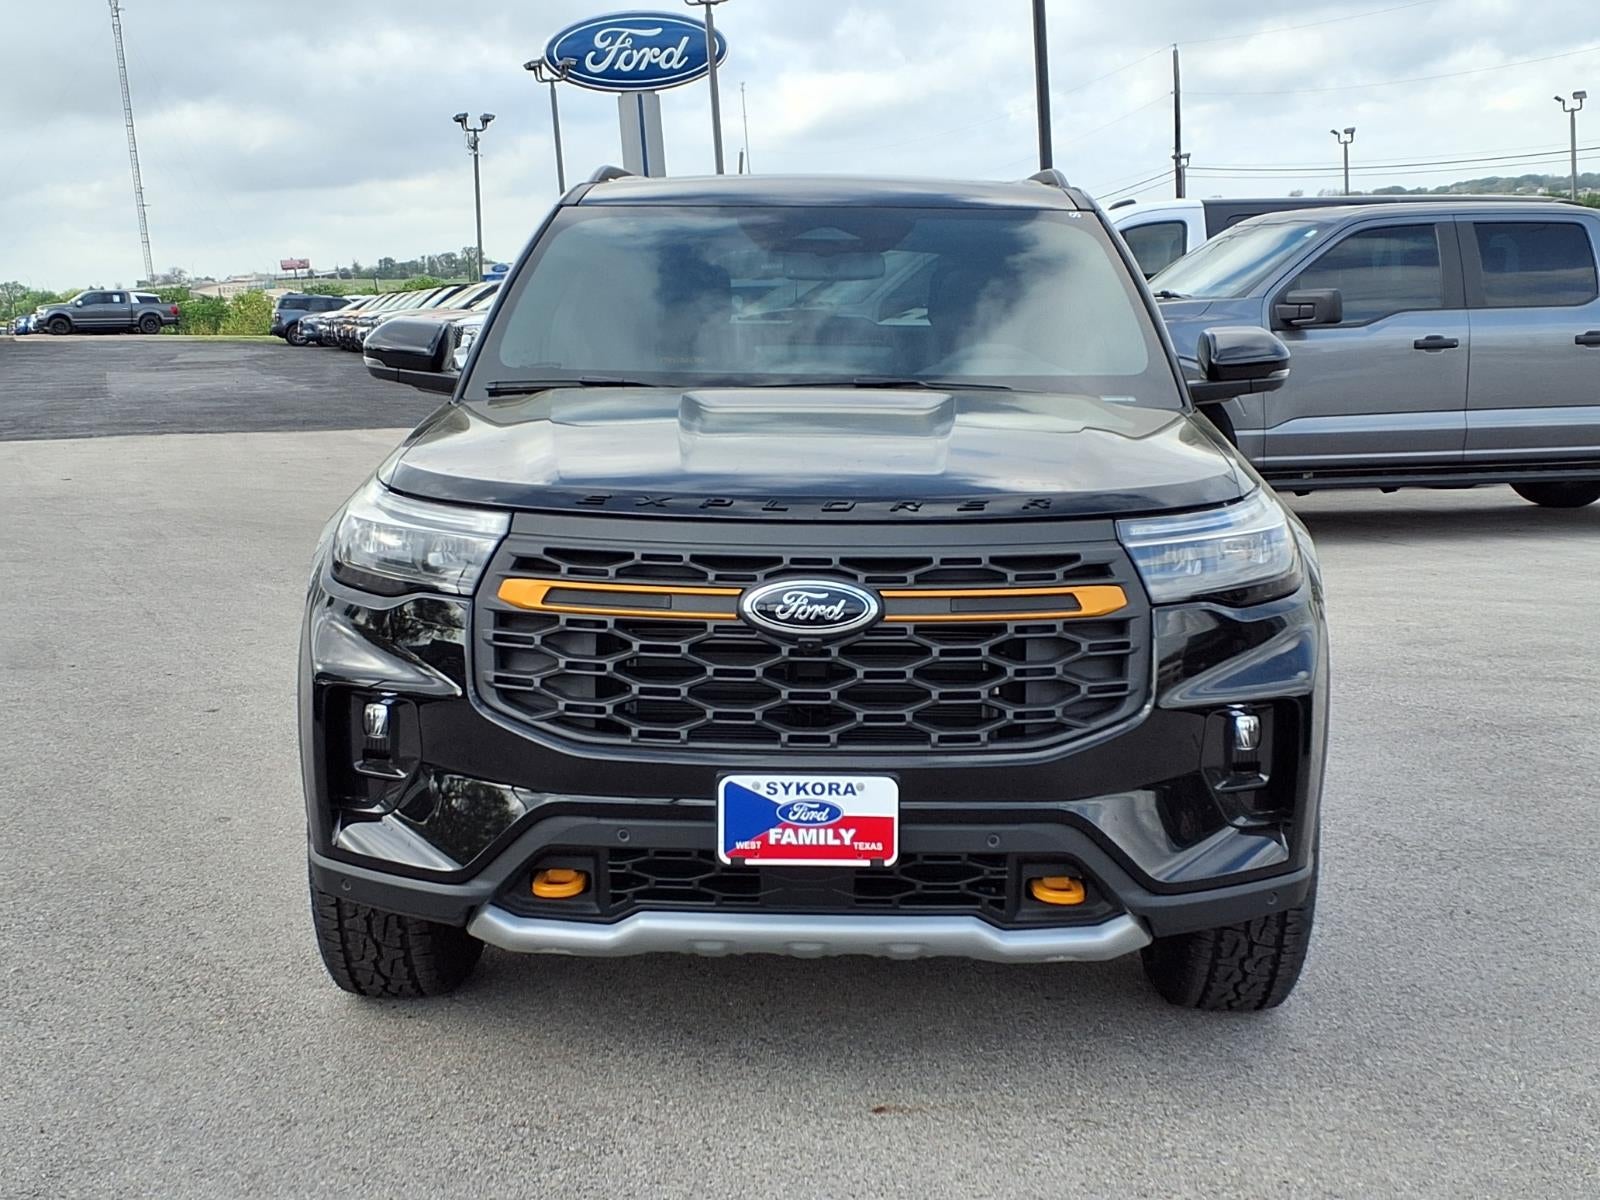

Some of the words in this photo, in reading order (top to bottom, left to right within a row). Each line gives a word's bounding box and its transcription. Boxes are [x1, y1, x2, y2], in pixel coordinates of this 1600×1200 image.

[585, 28, 690, 73] Ford
[576, 495, 1051, 512] EXPLORER
[775, 591, 846, 620] Ford
[766, 782, 856, 796] SYKORA
[788, 802, 829, 821] Ford
[735, 841, 761, 849] WEST
[768, 828, 856, 846] FAMILY
[853, 842, 883, 850] TEXAS
